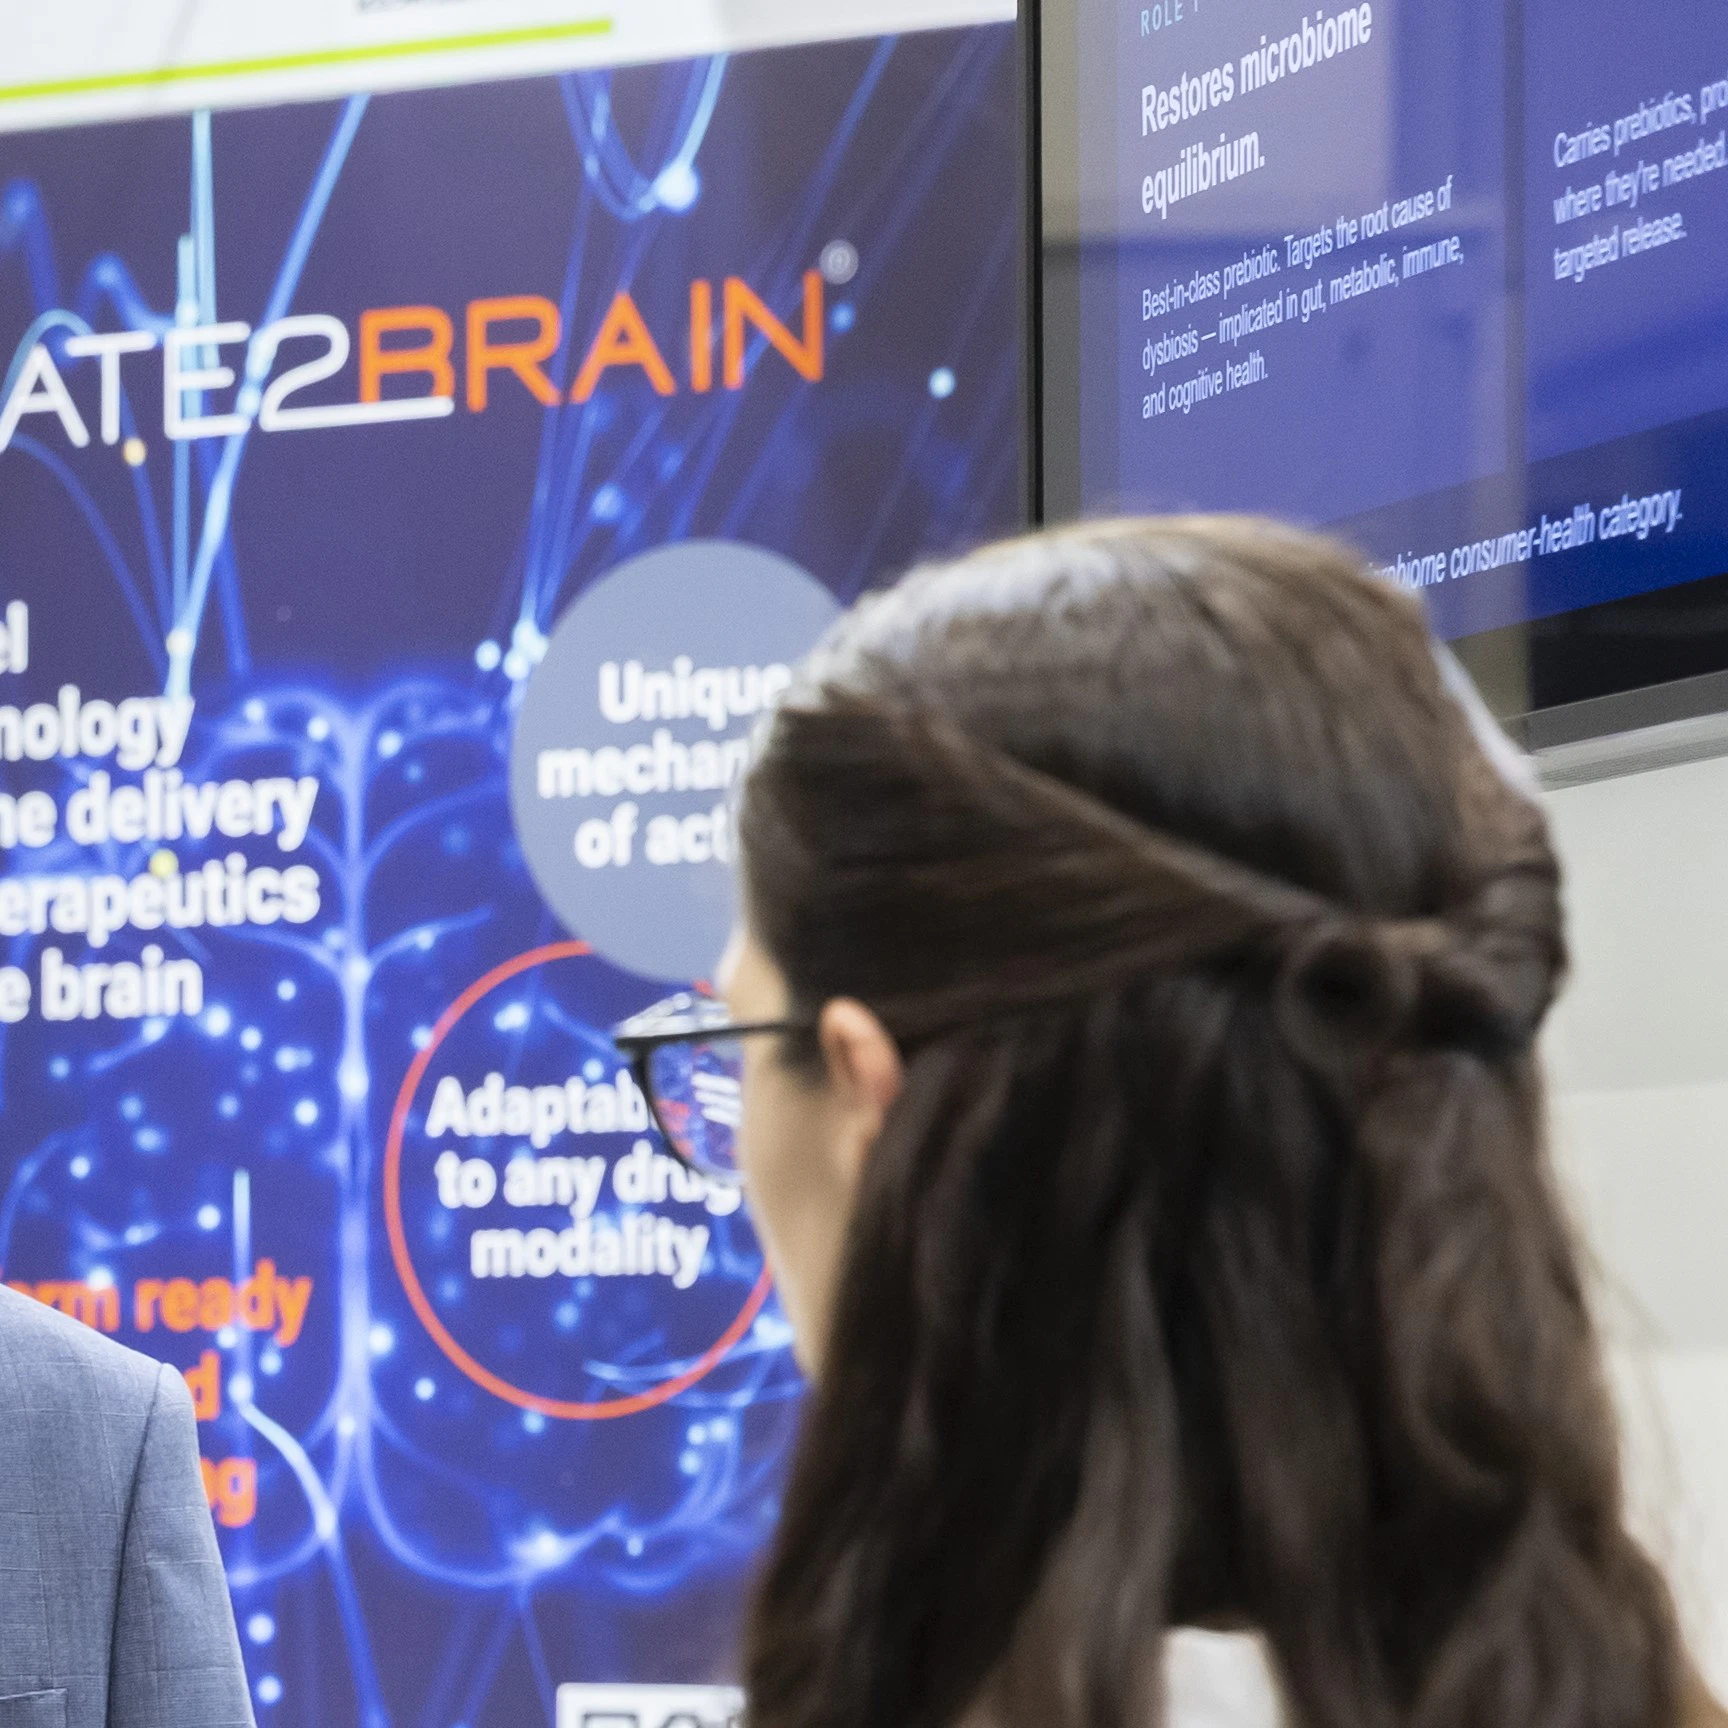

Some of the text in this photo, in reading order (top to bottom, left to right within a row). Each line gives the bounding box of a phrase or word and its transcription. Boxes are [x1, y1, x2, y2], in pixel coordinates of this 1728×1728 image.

[1140, 0, 1184, 37] ROLE
[1142, 2, 1372, 137] Restores microbiome
[1554, 121, 1612, 168] Carries
[1614, 90, 1698, 158] prebiotics,
[1142, 131, 1265, 220] equilibrium.
[1553, 185, 1602, 225] where
[1604, 160, 1660, 209] they're
[1143, 174, 1453, 321] Best-in-class prebiotic. Targets the root cause of
[1553, 212, 1688, 283] targeted release.
[1143, 324, 1198, 377] dysbiosis
[1219, 290, 1283, 347] implicated
[1286, 287, 1298, 321] in
[1301, 278, 1327, 324] gut,
[1330, 252, 1399, 305] metabolic,
[1402, 235, 1464, 280] immune,
[1143, 349, 1268, 419] and cognitive health.
[1450, 501, 1595, 579] consumer-health
[1599, 488, 1683, 541] category.
[66, 766, 320, 852] delivery
[573, 800, 639, 869] of
[40, 944, 204, 1021] brain
[425, 1068, 656, 1149] Adaptab
[434, 1149, 497, 1209] to
[503, 1154, 607, 1219] any
[470, 1210, 710, 1289] modality
[134, 1258, 314, 1347] ready
